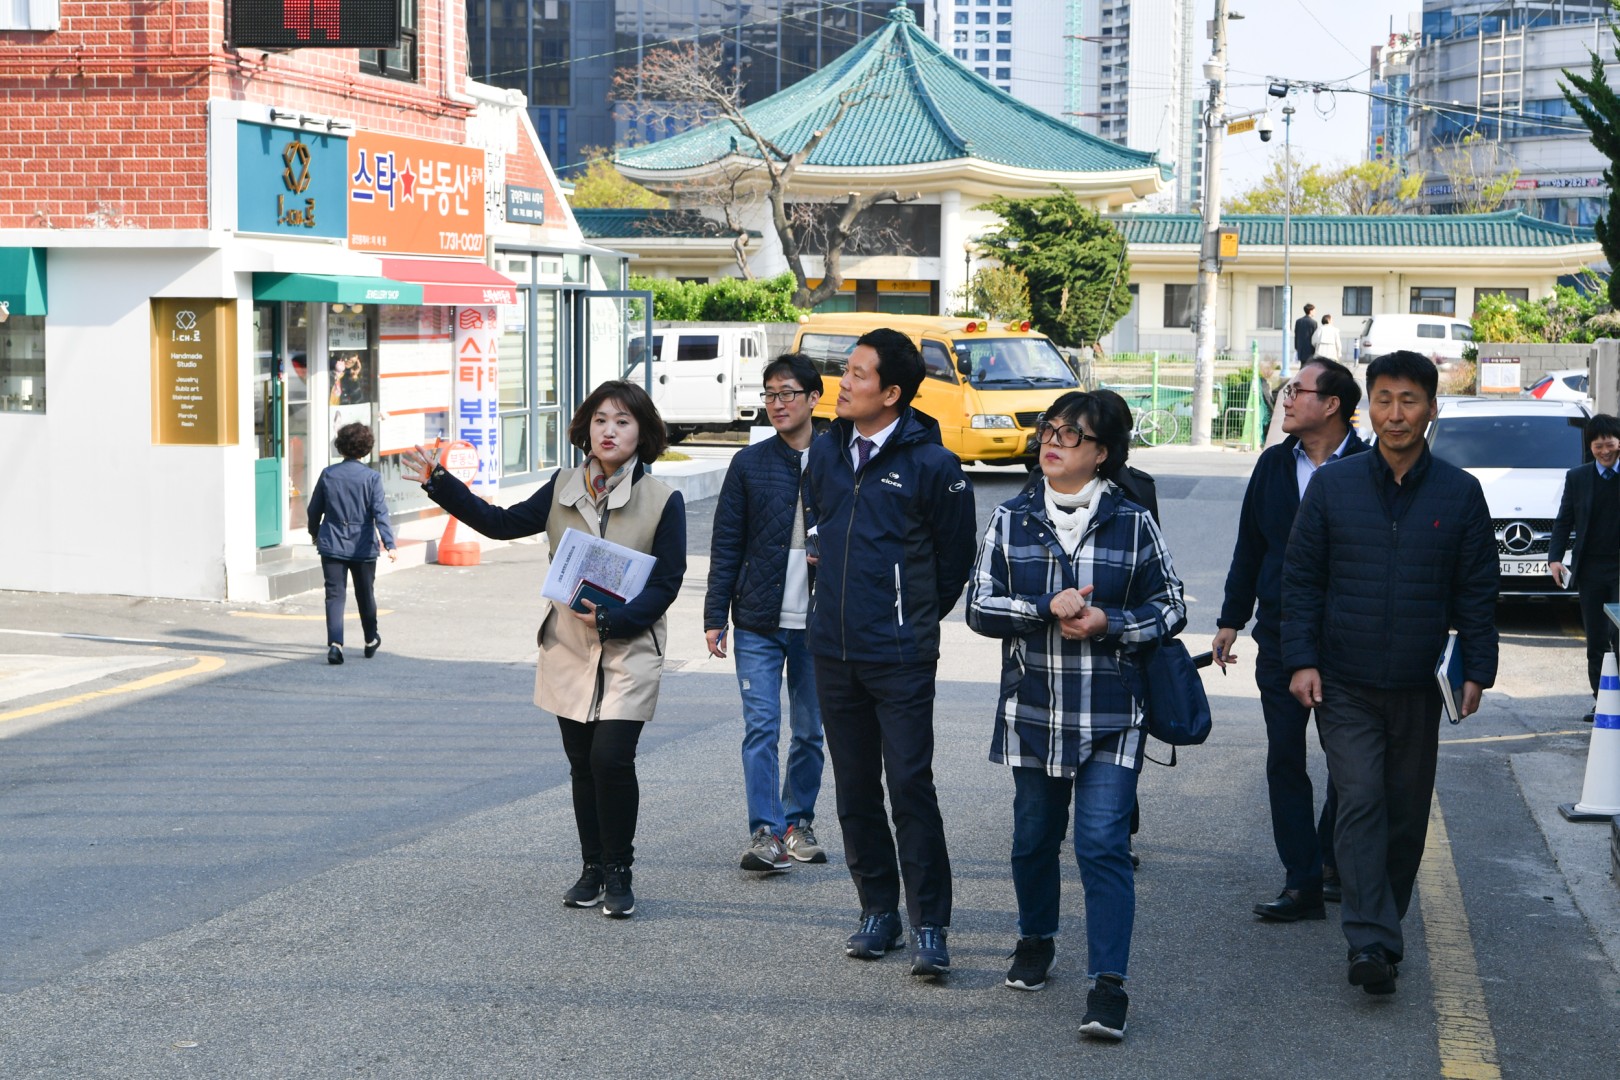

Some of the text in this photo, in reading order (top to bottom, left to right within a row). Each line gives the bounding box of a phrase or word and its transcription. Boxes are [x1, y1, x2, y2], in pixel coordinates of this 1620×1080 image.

[352, 149, 398, 211] 스타
[416, 159, 470, 216] 부동산
[171, 352, 203, 360] Handmade
[1517, 562, 1548, 574] 5244
